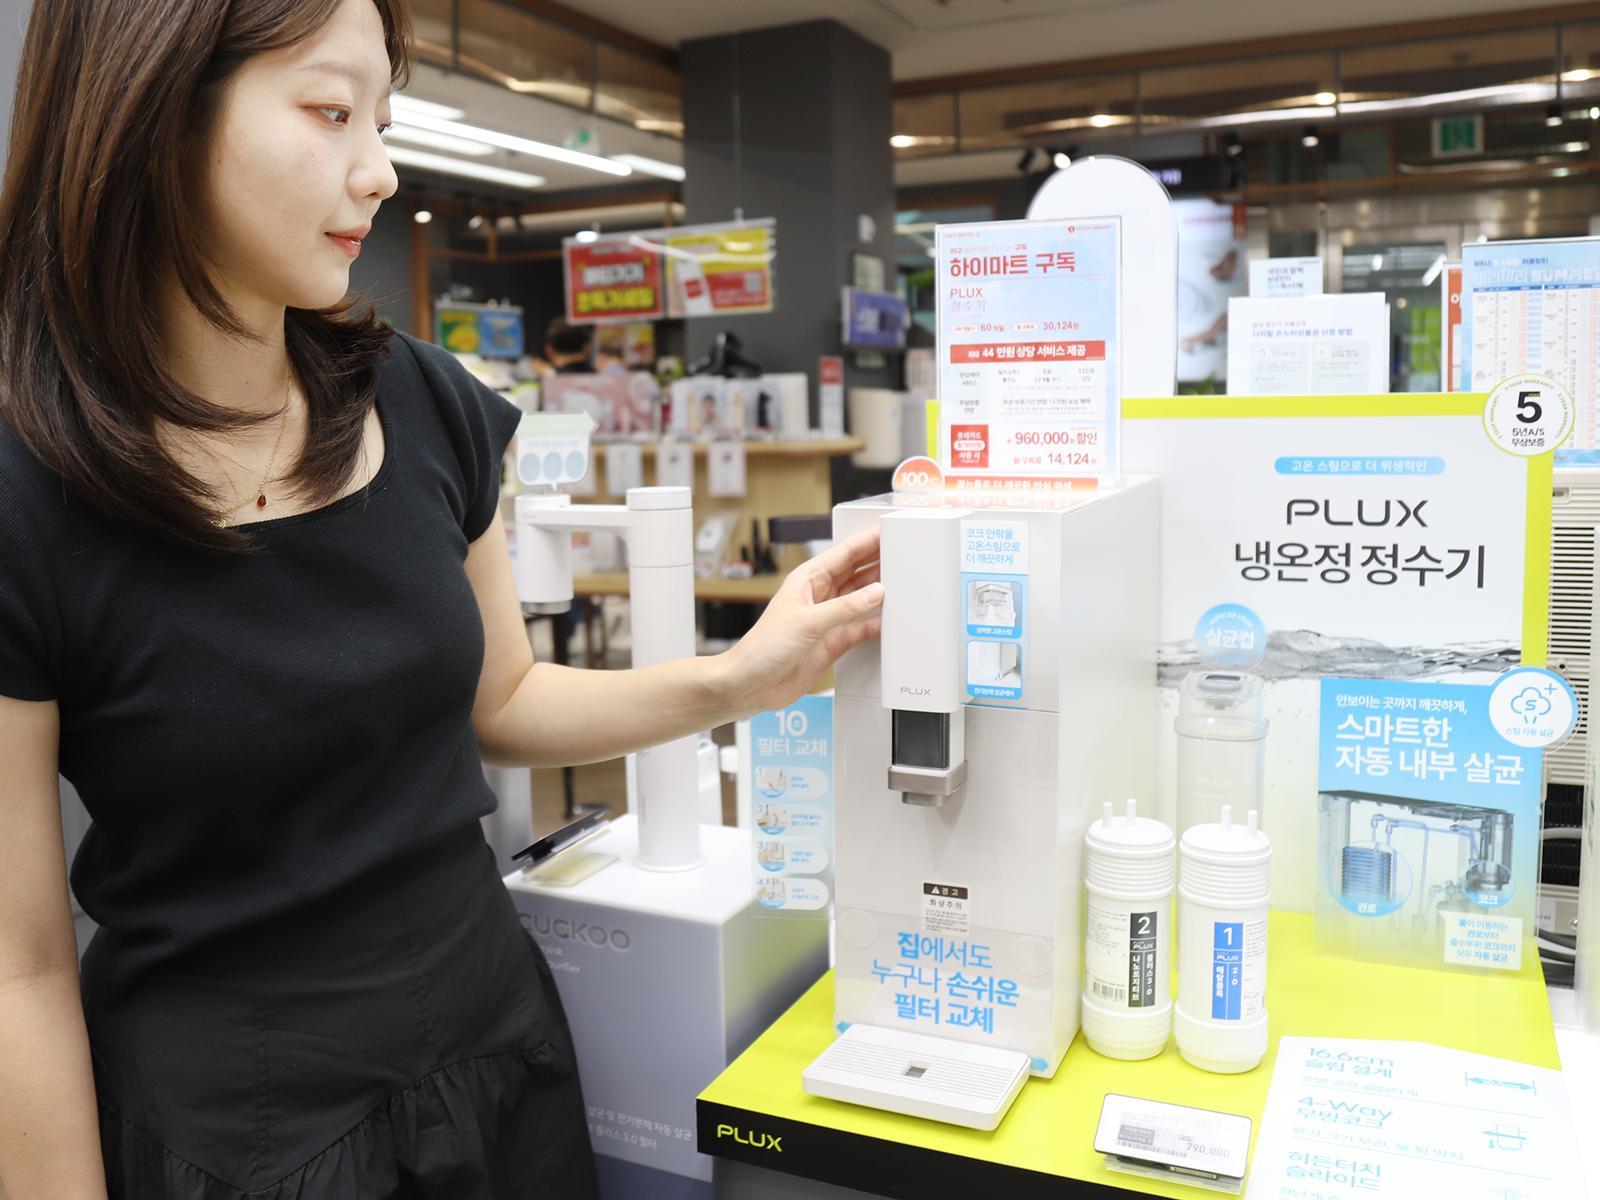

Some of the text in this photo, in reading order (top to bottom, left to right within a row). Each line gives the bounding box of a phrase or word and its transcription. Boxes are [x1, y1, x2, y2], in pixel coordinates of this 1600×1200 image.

[950, 251, 1076, 277] 하이마트 구독
[950, 287, 984, 298] PLUX
[951, 299, 986, 313] 정수기
[1252, 330, 1274, 338] 디지털
[982, 348, 994, 357] 44
[1016, 346, 1035, 358] 상당
[1037, 345, 1066, 357] 서비스
[1067, 344, 1086, 357] 제공
[1516, 390, 1543, 424] 5
[1076, 432, 1098, 445] 할인
[1511, 438, 1546, 447] 무상보증
[1291, 459, 1427, 474] 고온 스팀으로 더 위생적인
[1285, 499, 1429, 528] PLUX
[966, 528, 985, 538] 코크
[966, 540, 1022, 553] 고온스팀으로
[966, 552, 1014, 565] 더 깨끗하게
[1234, 541, 1487, 590] 냉온정 정수기
[1205, 627, 1255, 650] 살균컵
[900, 686, 931, 697] PLUX
[1336, 694, 1381, 709] 안보이는
[1382, 696, 1417, 711] 곳까지
[1335, 713, 1453, 749] 스마트한
[757, 738, 828, 758] 필터 교체
[1335, 745, 1525, 785] 자동 내부 살균
[1478, 894, 1498, 906] 코크
[517, 912, 631, 952] CUCKOO
[1137, 916, 1151, 935] 2
[1223, 927, 1233, 946] 1
[896, 931, 993, 969] 집에서도
[870, 959, 1020, 1007] 누구나 손쉬운
[894, 992, 994, 1034] 필터 교체
[1307, 1047, 1394, 1067] 16.6cm
[1305, 1058, 1392, 1079] 슬림 설계
[1297, 1096, 1392, 1122] 4-Way
[716, 1123, 783, 1153] PLUX
[1287, 1150, 1382, 1178] 히든터치
[1284, 1164, 1382, 1192] 슬라이드
